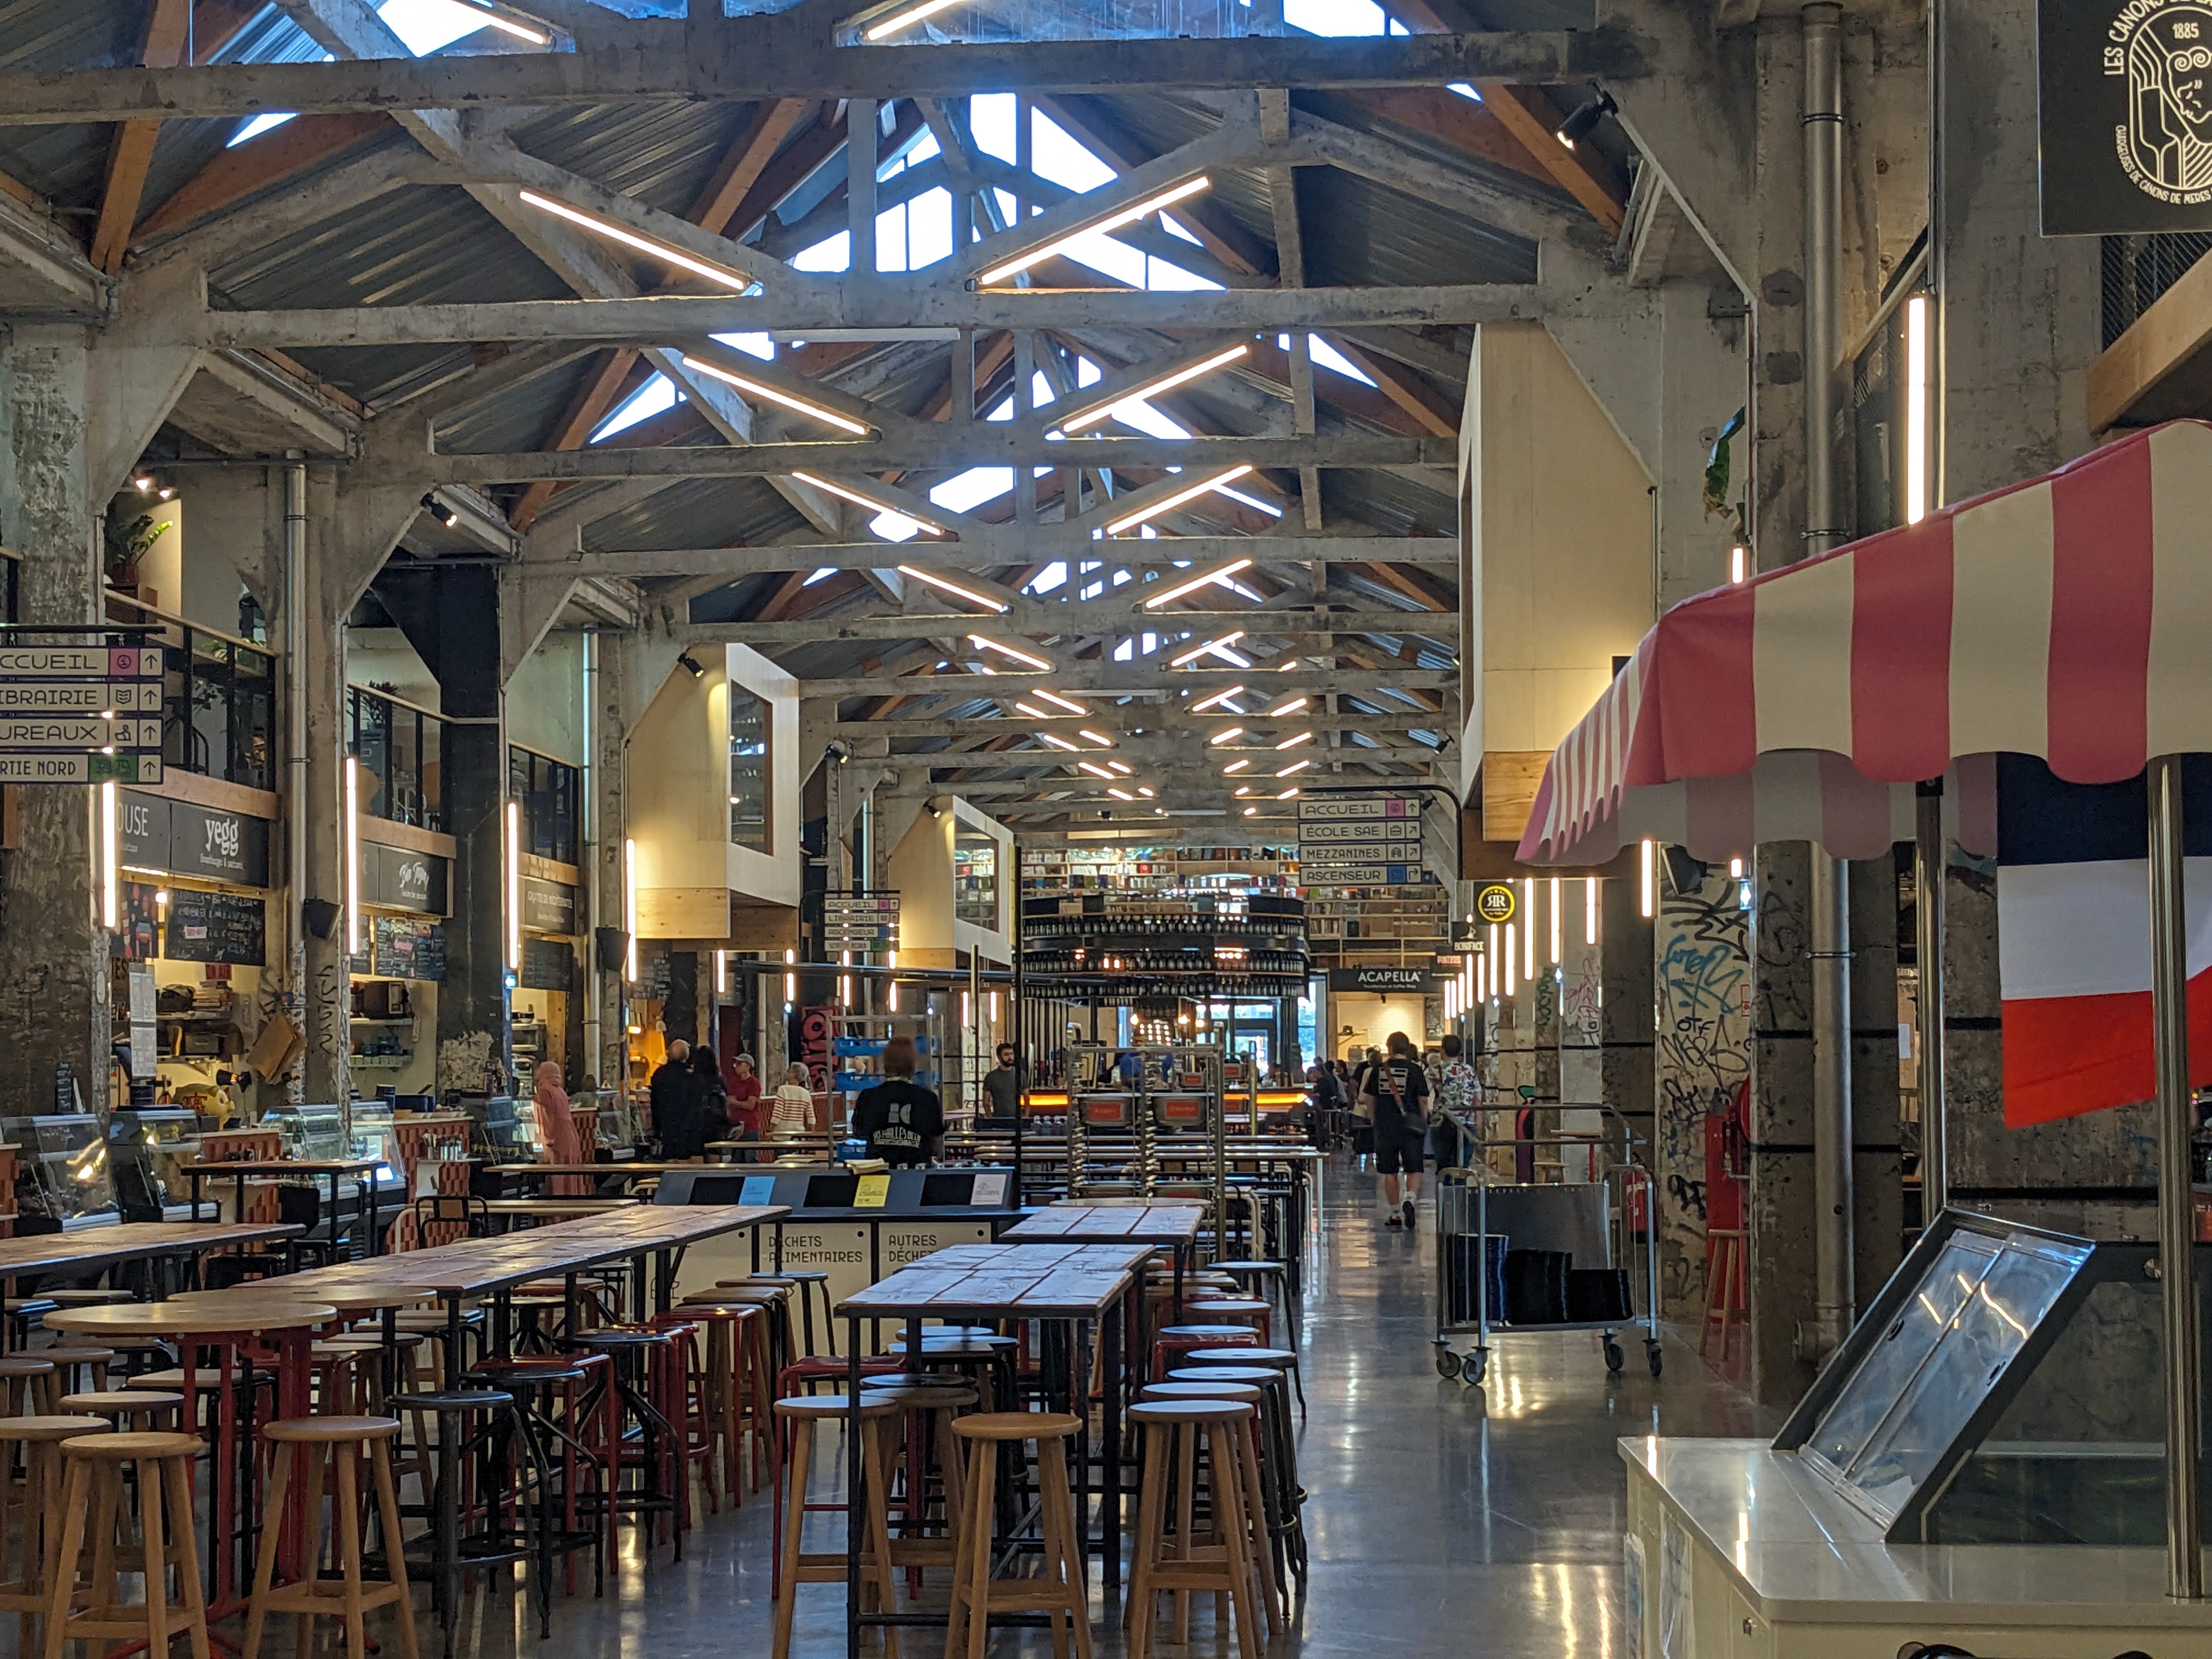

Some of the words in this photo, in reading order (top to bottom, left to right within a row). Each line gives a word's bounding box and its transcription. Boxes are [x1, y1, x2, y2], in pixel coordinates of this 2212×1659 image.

[2172, 22, 2199, 39] 1885
[2104, 47, 2124, 75] LES
[2129, 170, 2143, 184] DE
[2140, 180, 2169, 201] CANONS
[2170, 193, 2182, 205] DE
[0, 654, 98, 669] CCUEIL
[0, 725, 97, 741] UREAUX
[37, 760, 76, 776] NORD
[1305, 804, 1379, 815] ACCUEIL
[205, 817, 239, 857] yegg
[1306, 825, 1350, 838] ÉCOLE
[1354, 826, 1380, 837] SAE
[1306, 848, 1380, 860] MEZZANINES
[1307, 870, 1381, 881] ASCENSEUR
[1358, 971, 1421, 983] ACAPELLA
[769, 1235, 822, 1247] DCHETS
[889, 1234, 936, 1246] AUTRES
[769, 1251, 862, 1263] AIMENTAIRES
